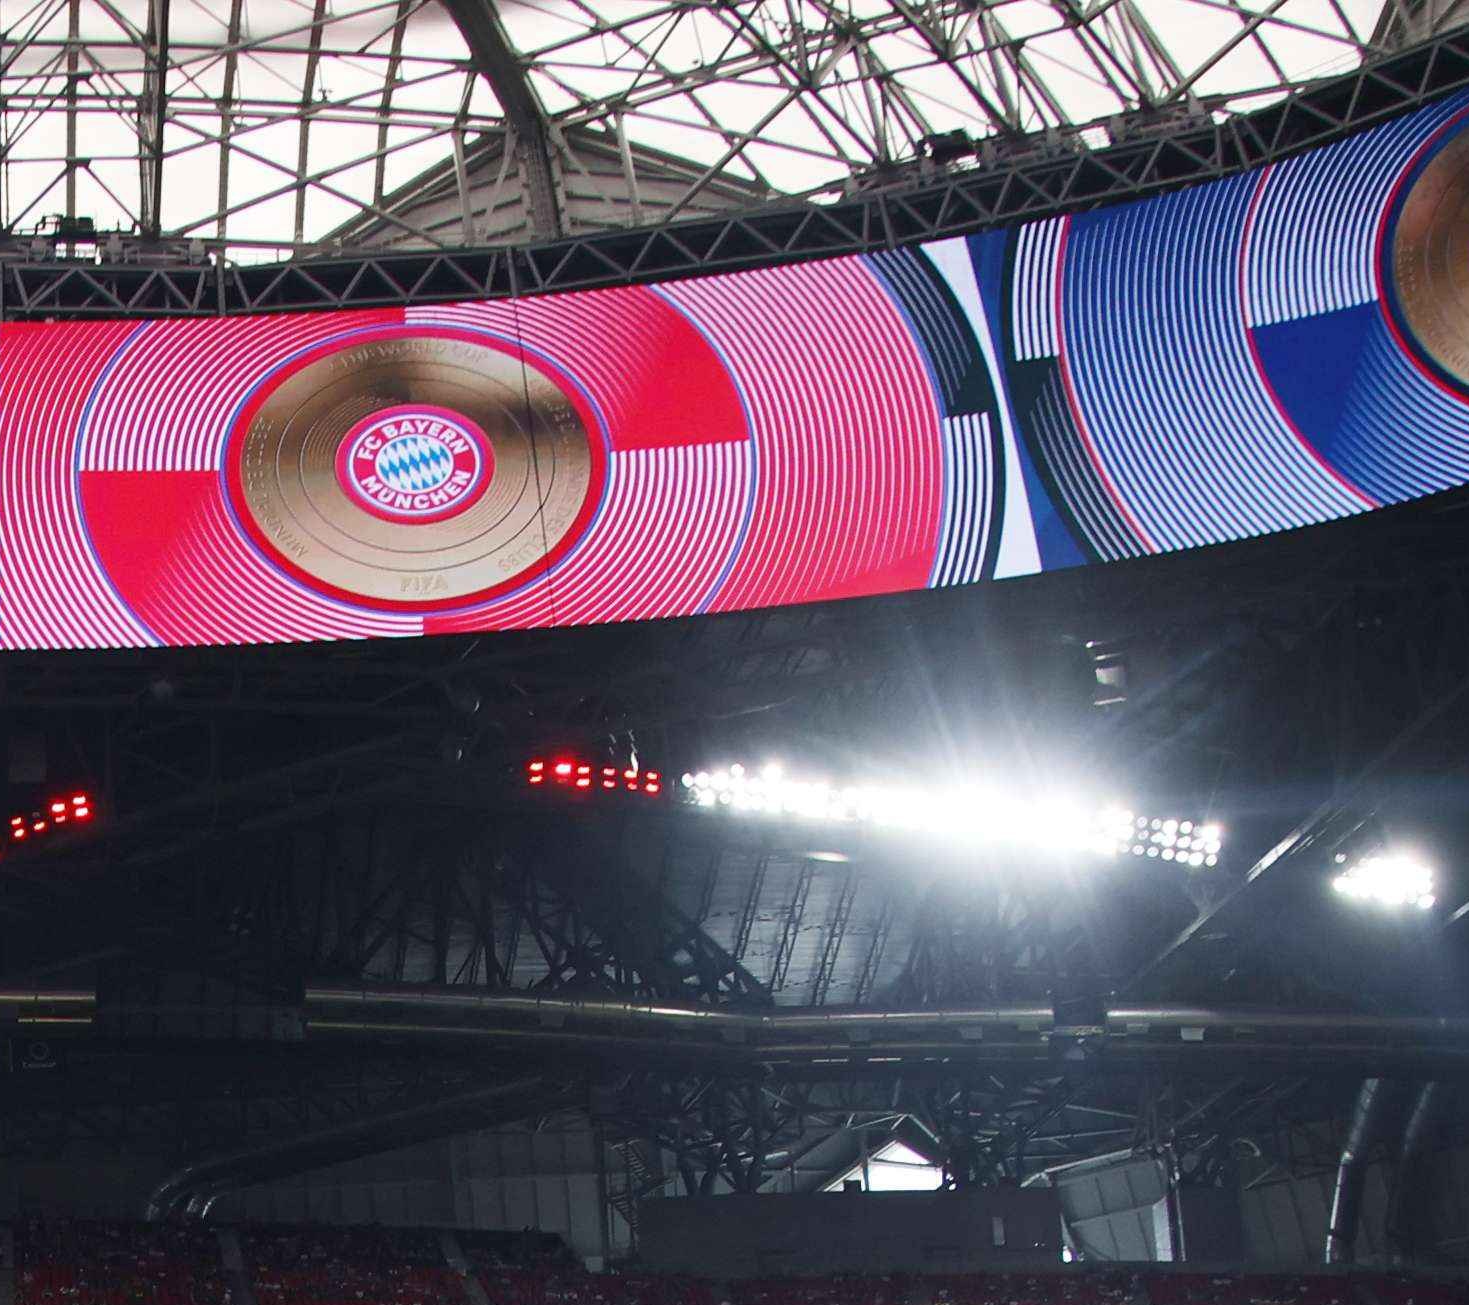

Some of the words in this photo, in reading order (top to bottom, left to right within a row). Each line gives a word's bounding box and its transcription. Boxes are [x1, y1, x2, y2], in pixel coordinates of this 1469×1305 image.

[356, 431, 382, 462] FC
[381, 420, 470, 455] BAYERN
[360, 468, 472, 510] MÜNCHEN
